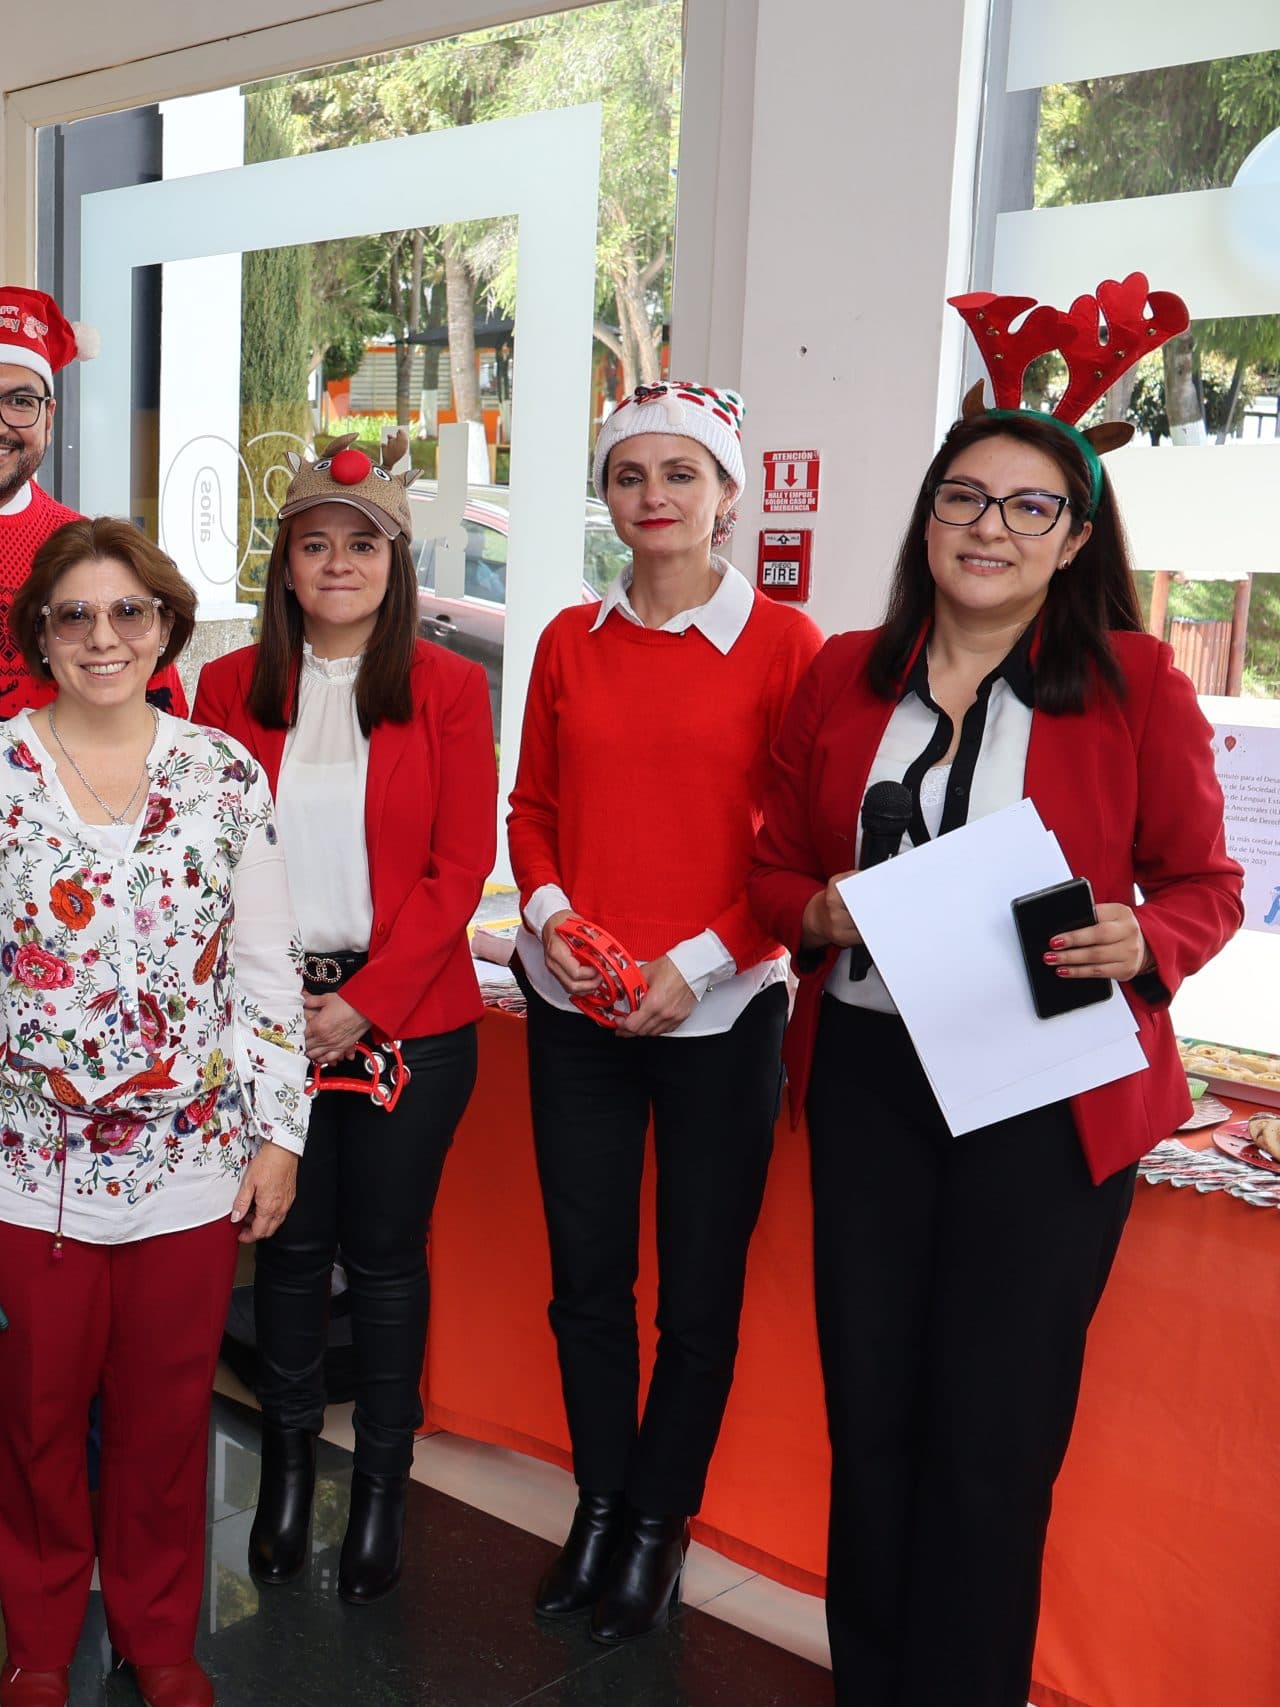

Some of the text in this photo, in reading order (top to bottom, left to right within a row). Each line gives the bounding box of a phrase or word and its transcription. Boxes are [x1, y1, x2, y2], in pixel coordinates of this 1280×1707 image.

[772, 451, 813, 461] ATENCIÓN
[764, 568, 797, 581] FIRE
[1225, 814, 1248, 822] acultad
